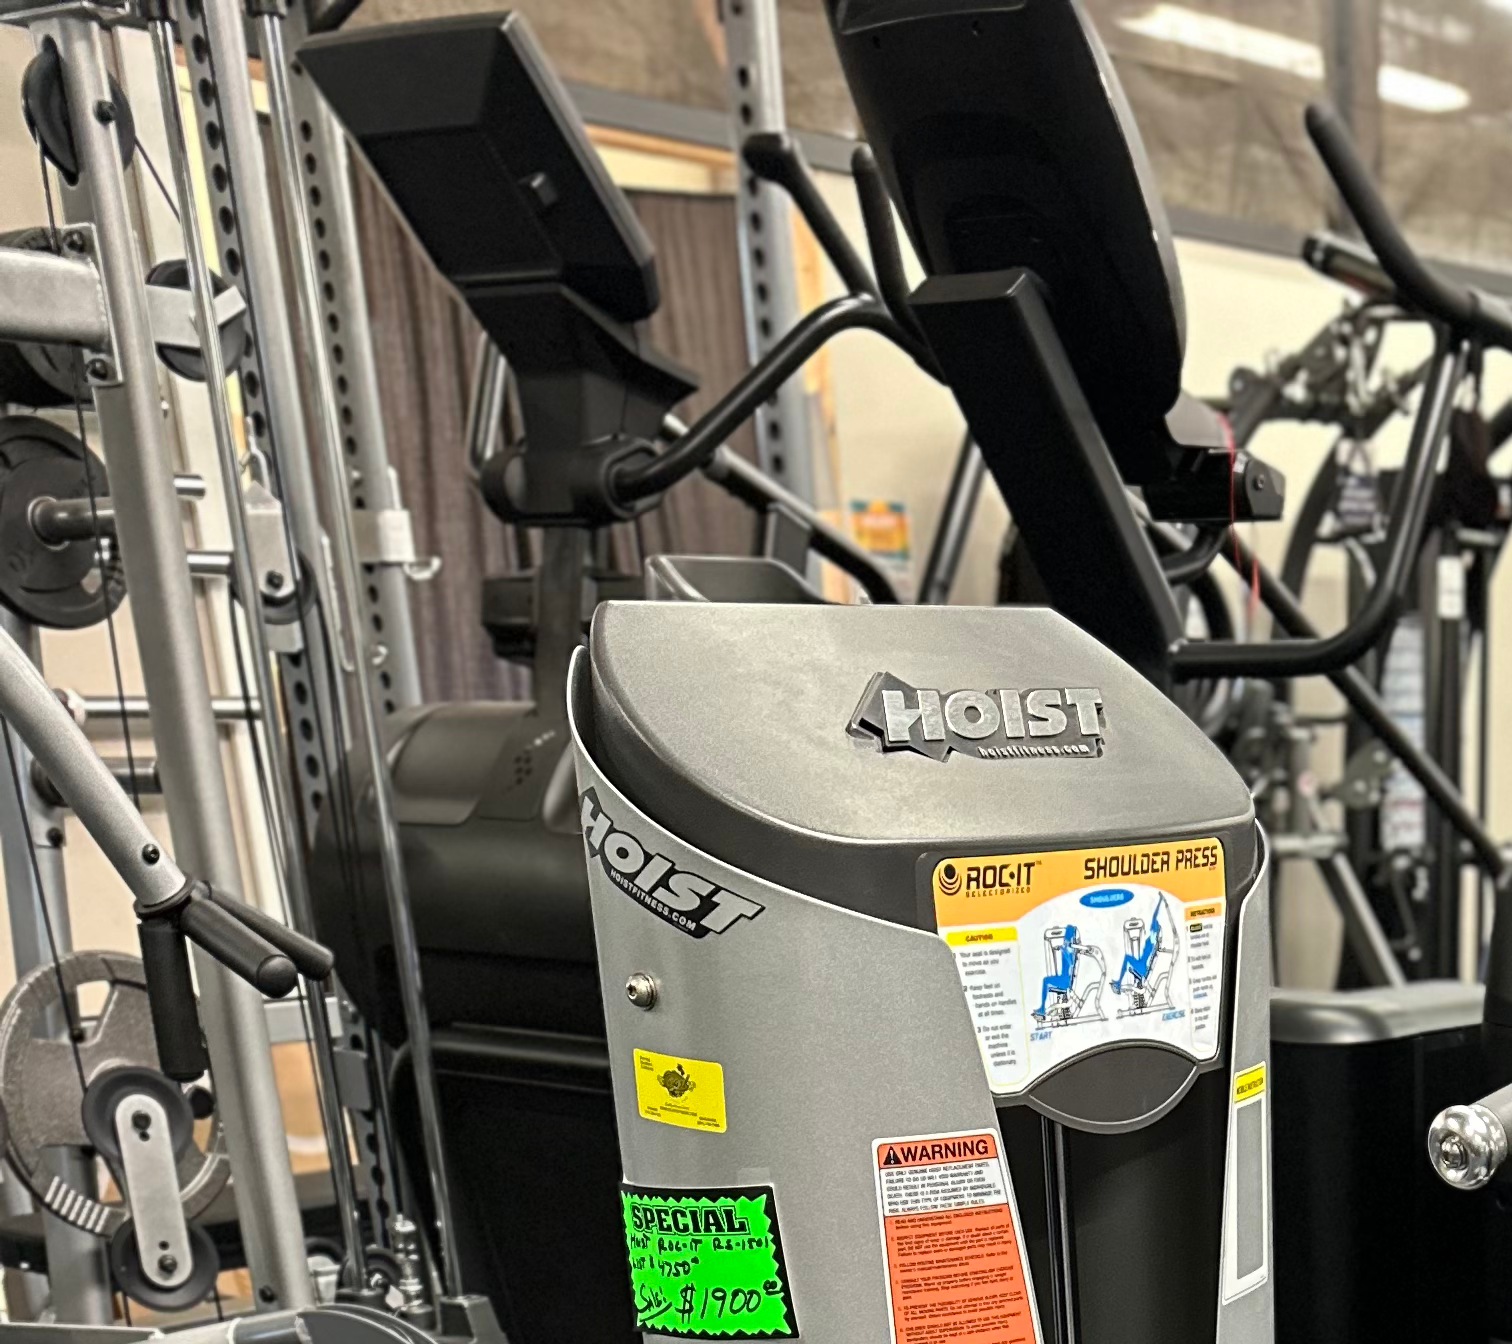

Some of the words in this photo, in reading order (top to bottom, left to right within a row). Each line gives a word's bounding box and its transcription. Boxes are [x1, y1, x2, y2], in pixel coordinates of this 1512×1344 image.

[882, 688, 1102, 742] HOIST
[978, 745, 1090, 758] hoistfitness.com
[581, 796, 763, 933] HOIST
[1084, 851, 1170, 880] SHOULDER
[1175, 845, 1218, 871] PRESS
[610, 869, 697, 931] HOISTFITNESS.COM
[1030, 1031, 1052, 1041] START
[900, 1139, 988, 1163] WARNING
[631, 1205, 749, 1234] SPECIAL
